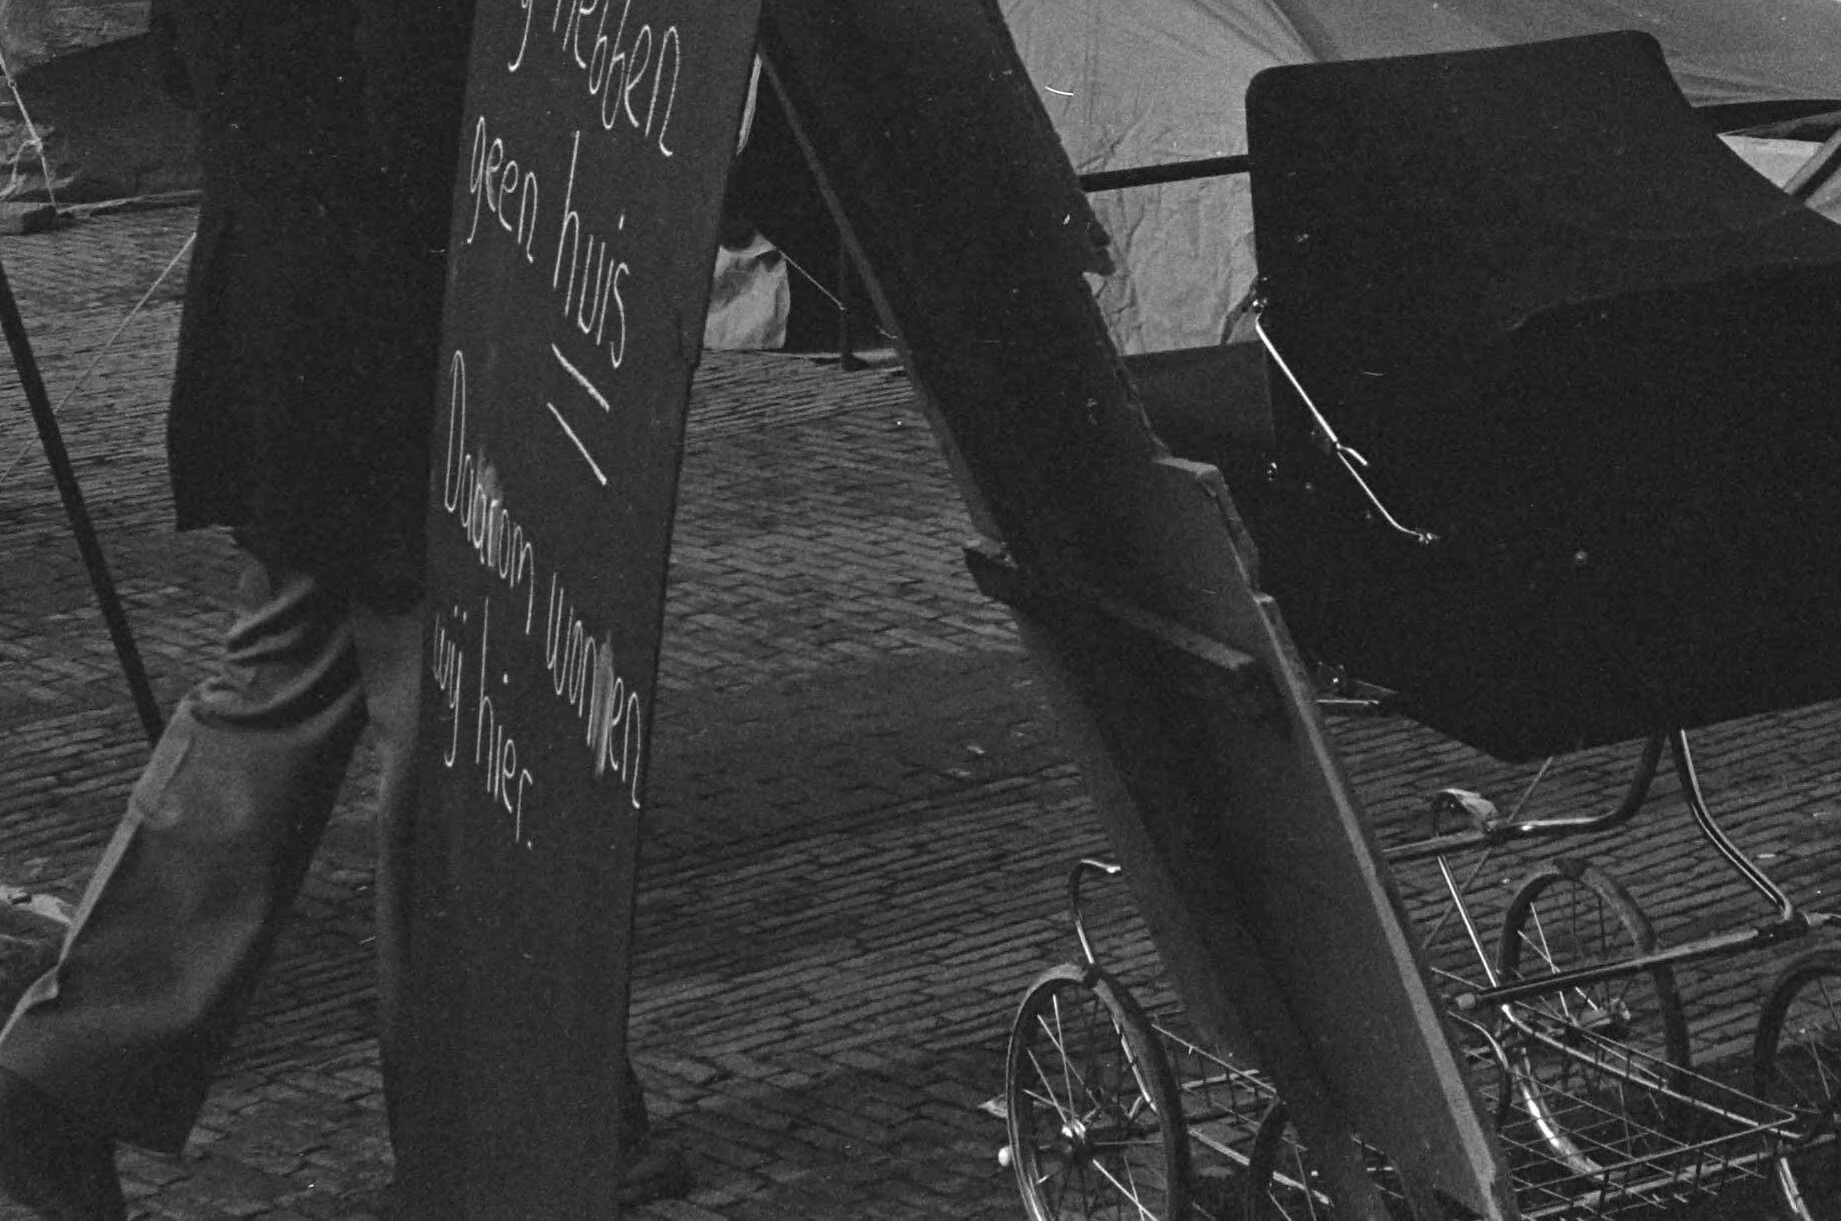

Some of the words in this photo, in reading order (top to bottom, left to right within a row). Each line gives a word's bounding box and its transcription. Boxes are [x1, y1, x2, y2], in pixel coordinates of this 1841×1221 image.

[465, 114, 538, 264] geen
[552, 129, 630, 369] huis
[444, 349, 535, 636] Daarom
